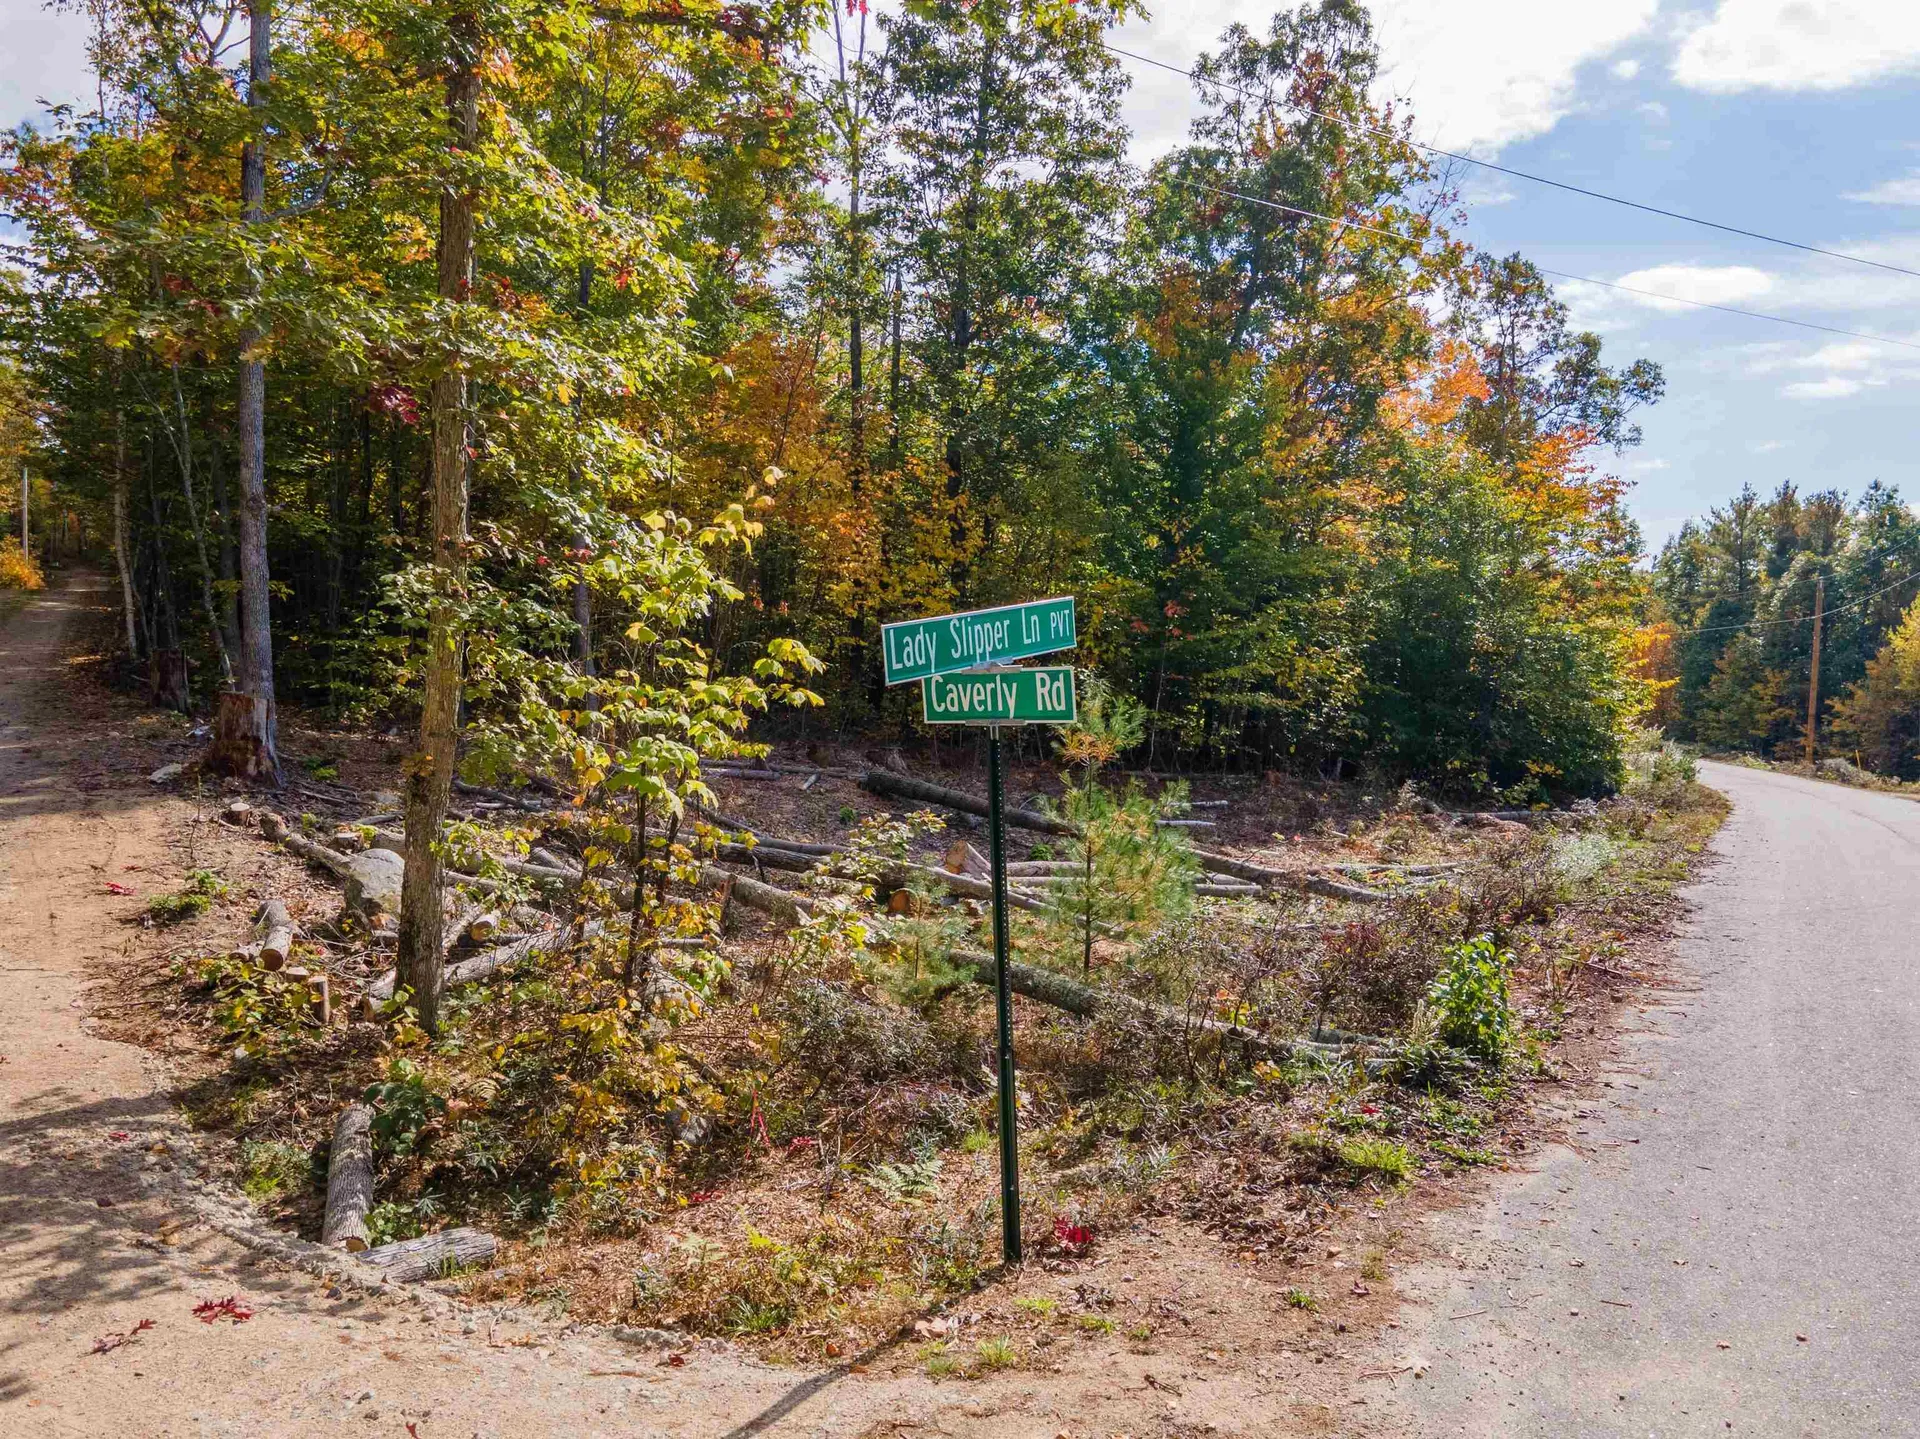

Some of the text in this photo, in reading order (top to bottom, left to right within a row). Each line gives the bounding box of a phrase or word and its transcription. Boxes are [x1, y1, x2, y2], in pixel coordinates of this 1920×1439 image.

[889, 608, 1070, 673] Lady Slipper Ln PVT
[931, 672, 1066, 719] Caverly Rd
